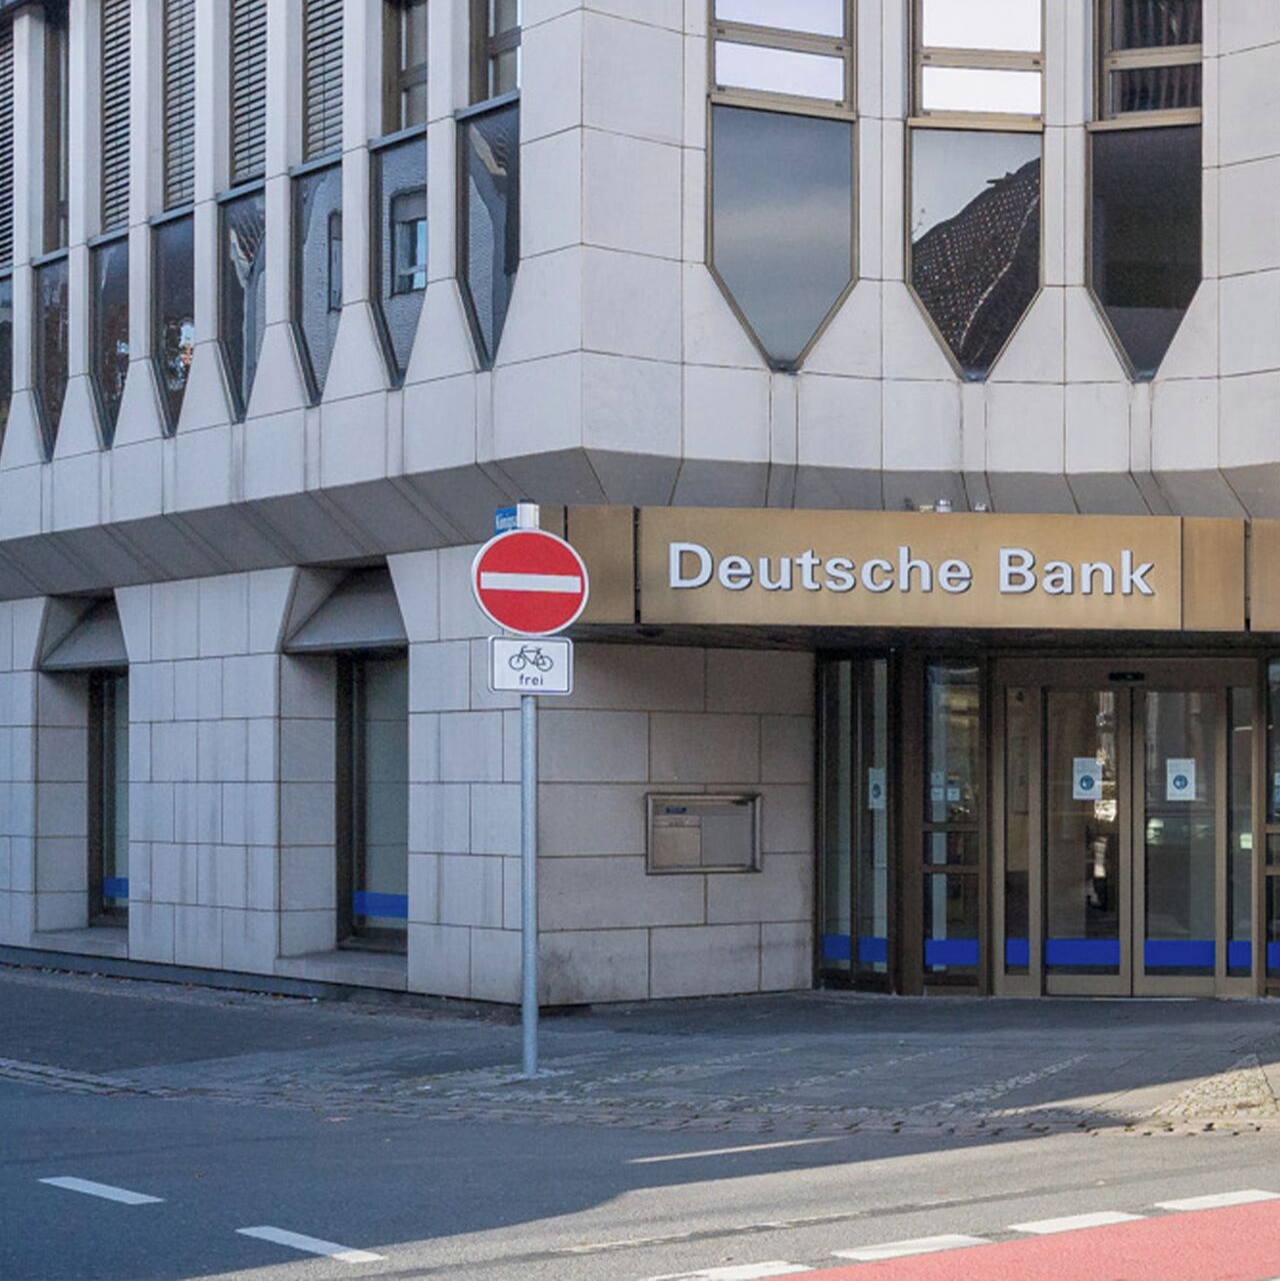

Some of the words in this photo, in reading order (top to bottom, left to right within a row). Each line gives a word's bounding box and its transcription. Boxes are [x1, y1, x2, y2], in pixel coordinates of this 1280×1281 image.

[669, 542, 973, 593] Deutsche
[1000, 547, 1156, 596] Bank
[519, 673, 544, 686] frei
